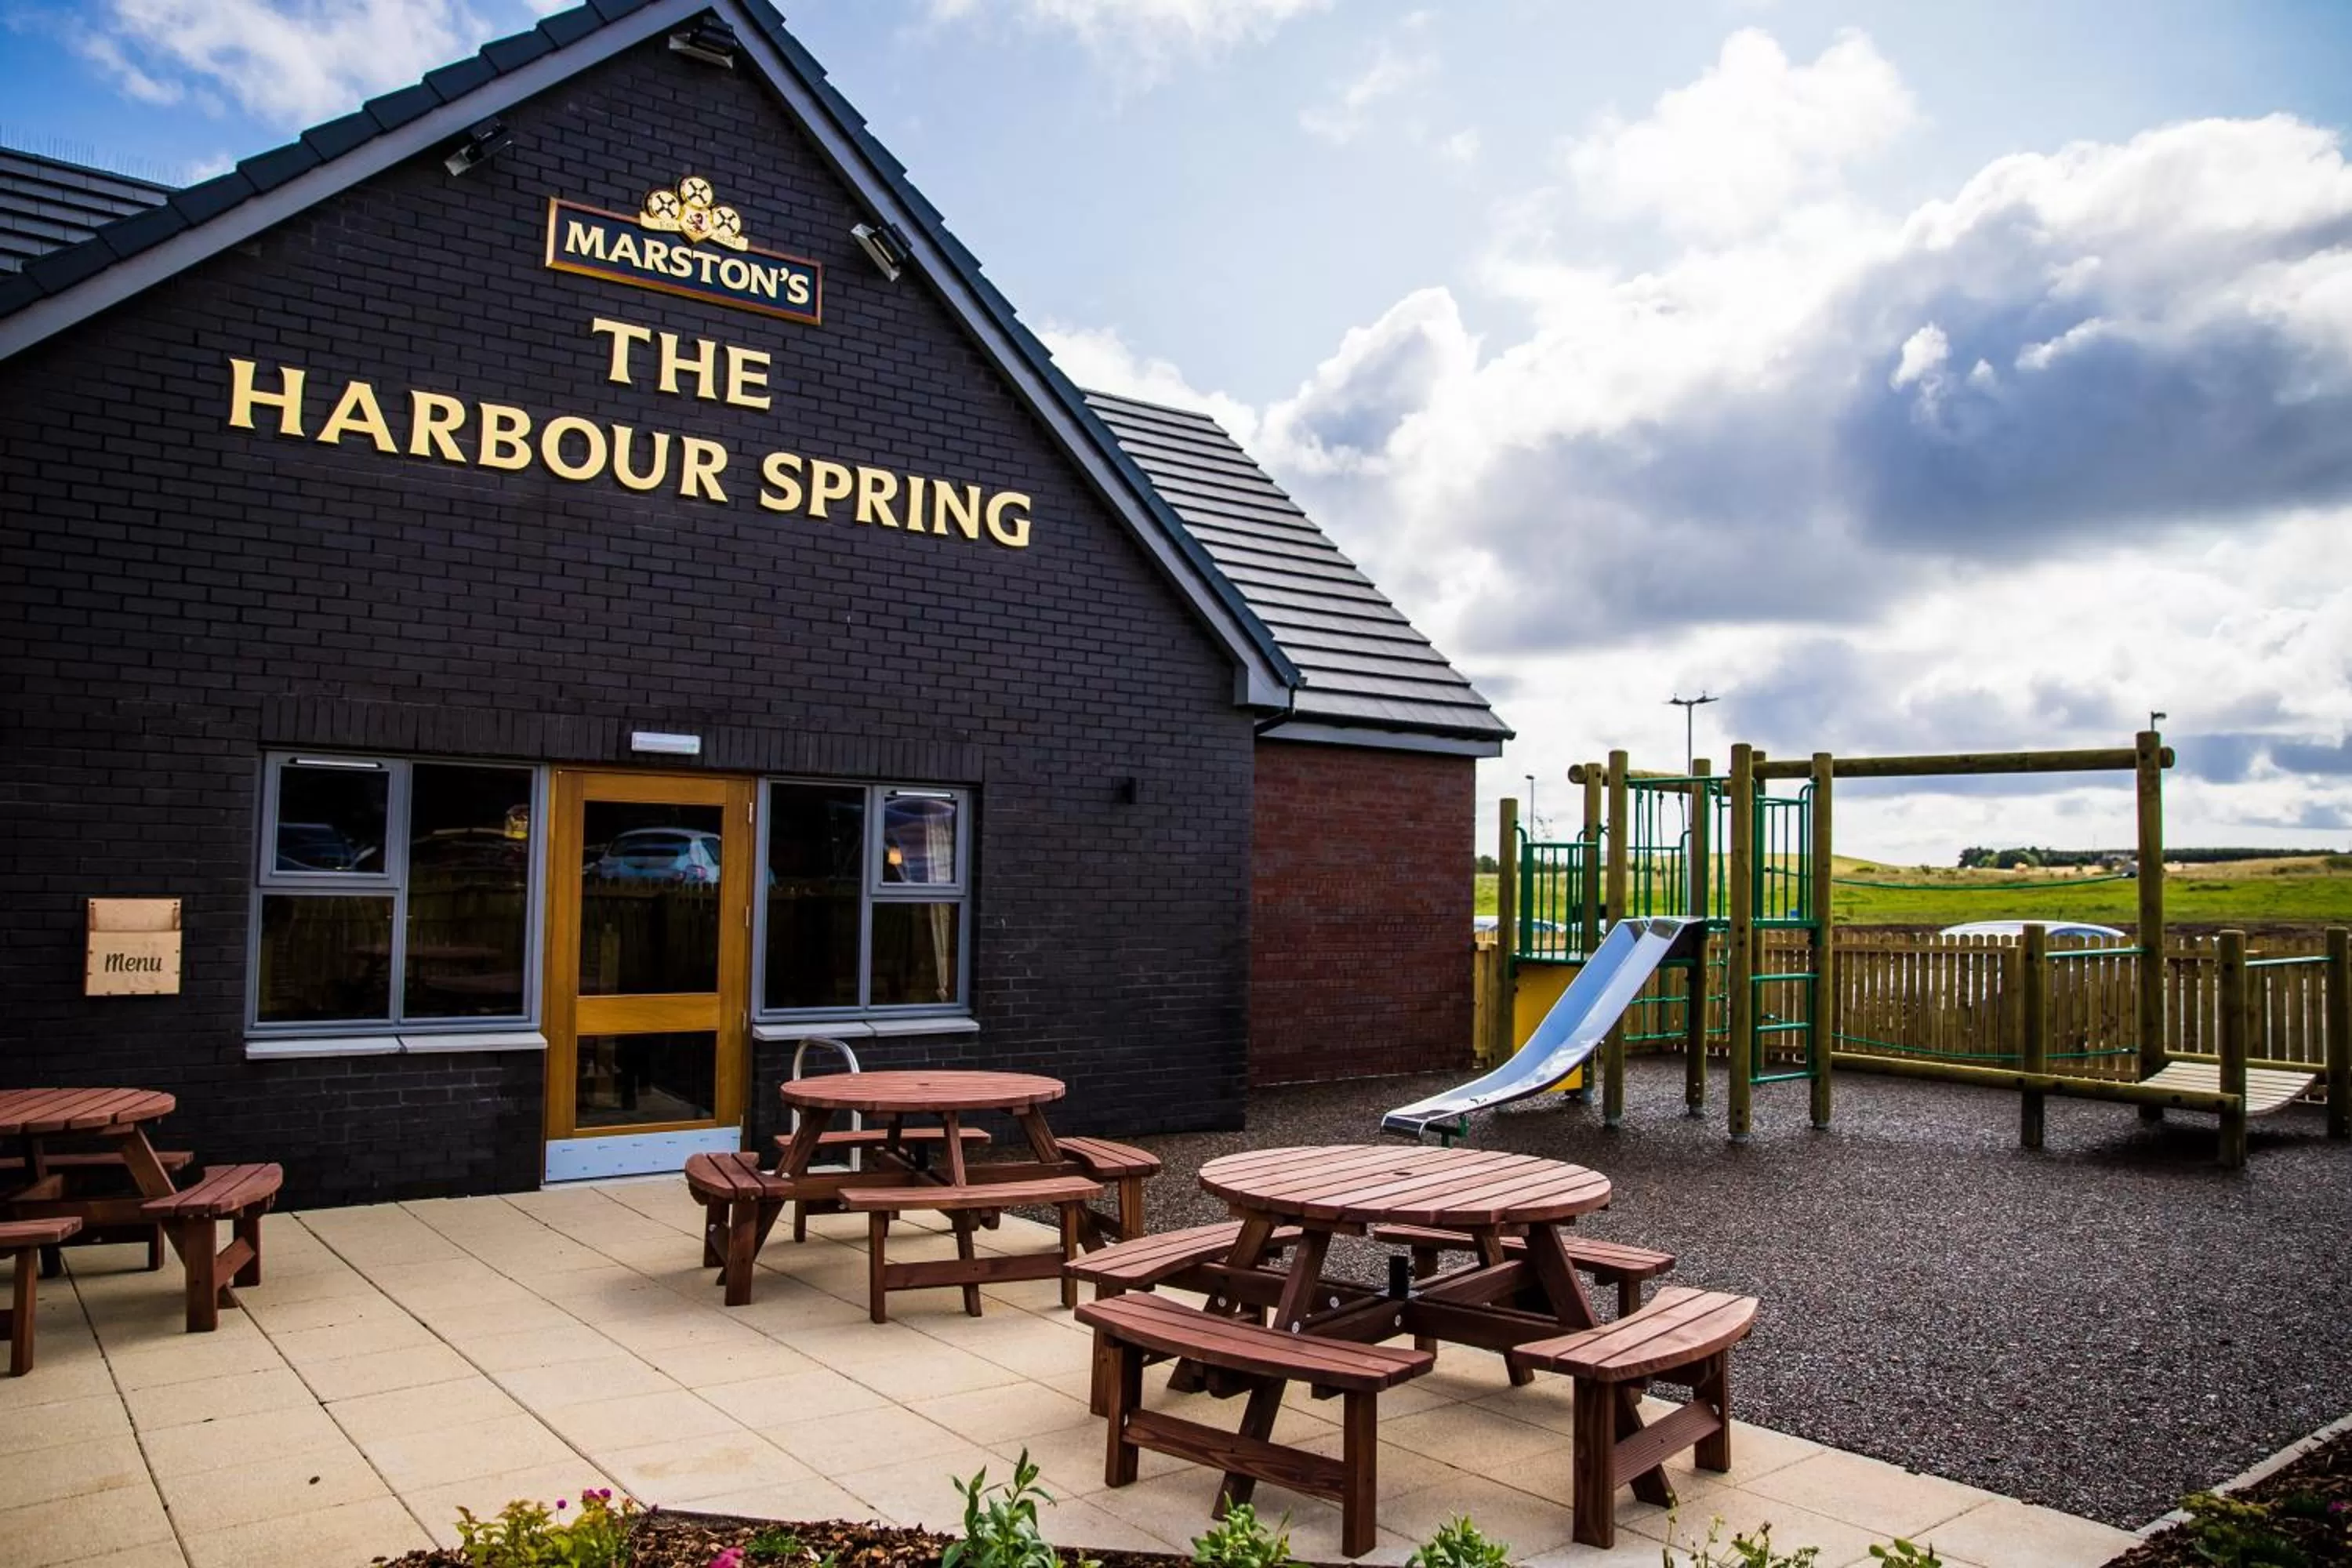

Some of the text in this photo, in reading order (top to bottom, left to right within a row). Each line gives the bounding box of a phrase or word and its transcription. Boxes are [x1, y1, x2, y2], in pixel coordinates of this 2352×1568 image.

[565, 220, 809, 304] MARSTON'S
[593, 318, 771, 410] THE
[229, 358, 1031, 546] HARBOUR SPRING
[104, 953, 162, 973] Menu
